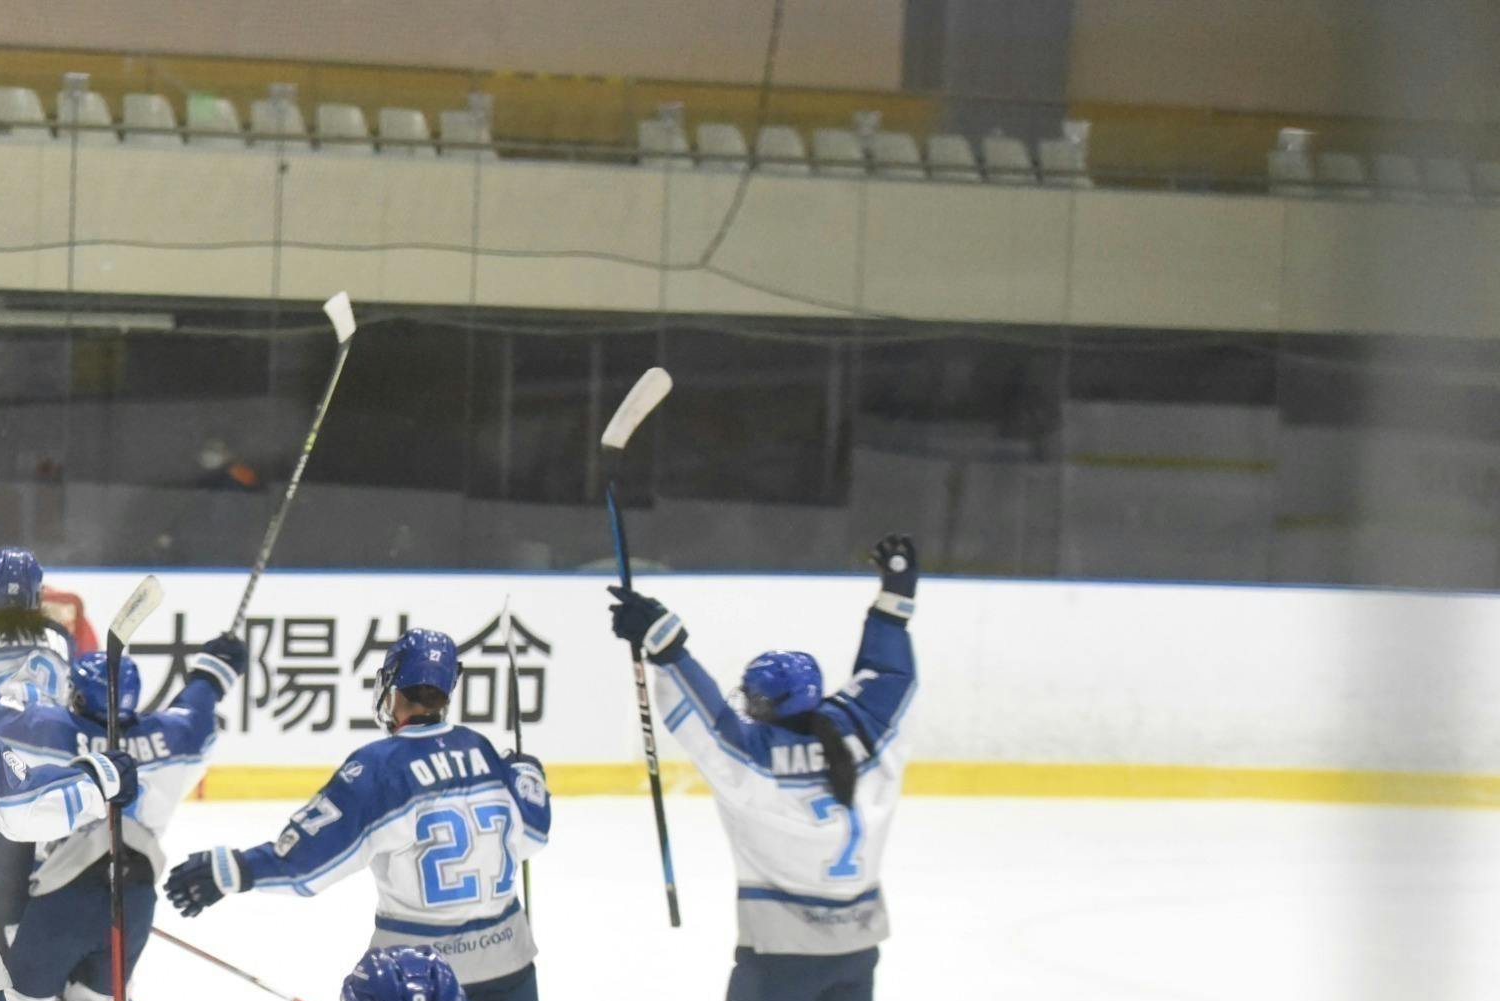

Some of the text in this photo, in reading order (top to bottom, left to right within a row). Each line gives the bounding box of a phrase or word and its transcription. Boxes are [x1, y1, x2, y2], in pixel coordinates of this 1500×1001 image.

[410, 748, 490, 786] OHTA
[415, 799, 519, 908] 27
[809, 795, 865, 882] 7
